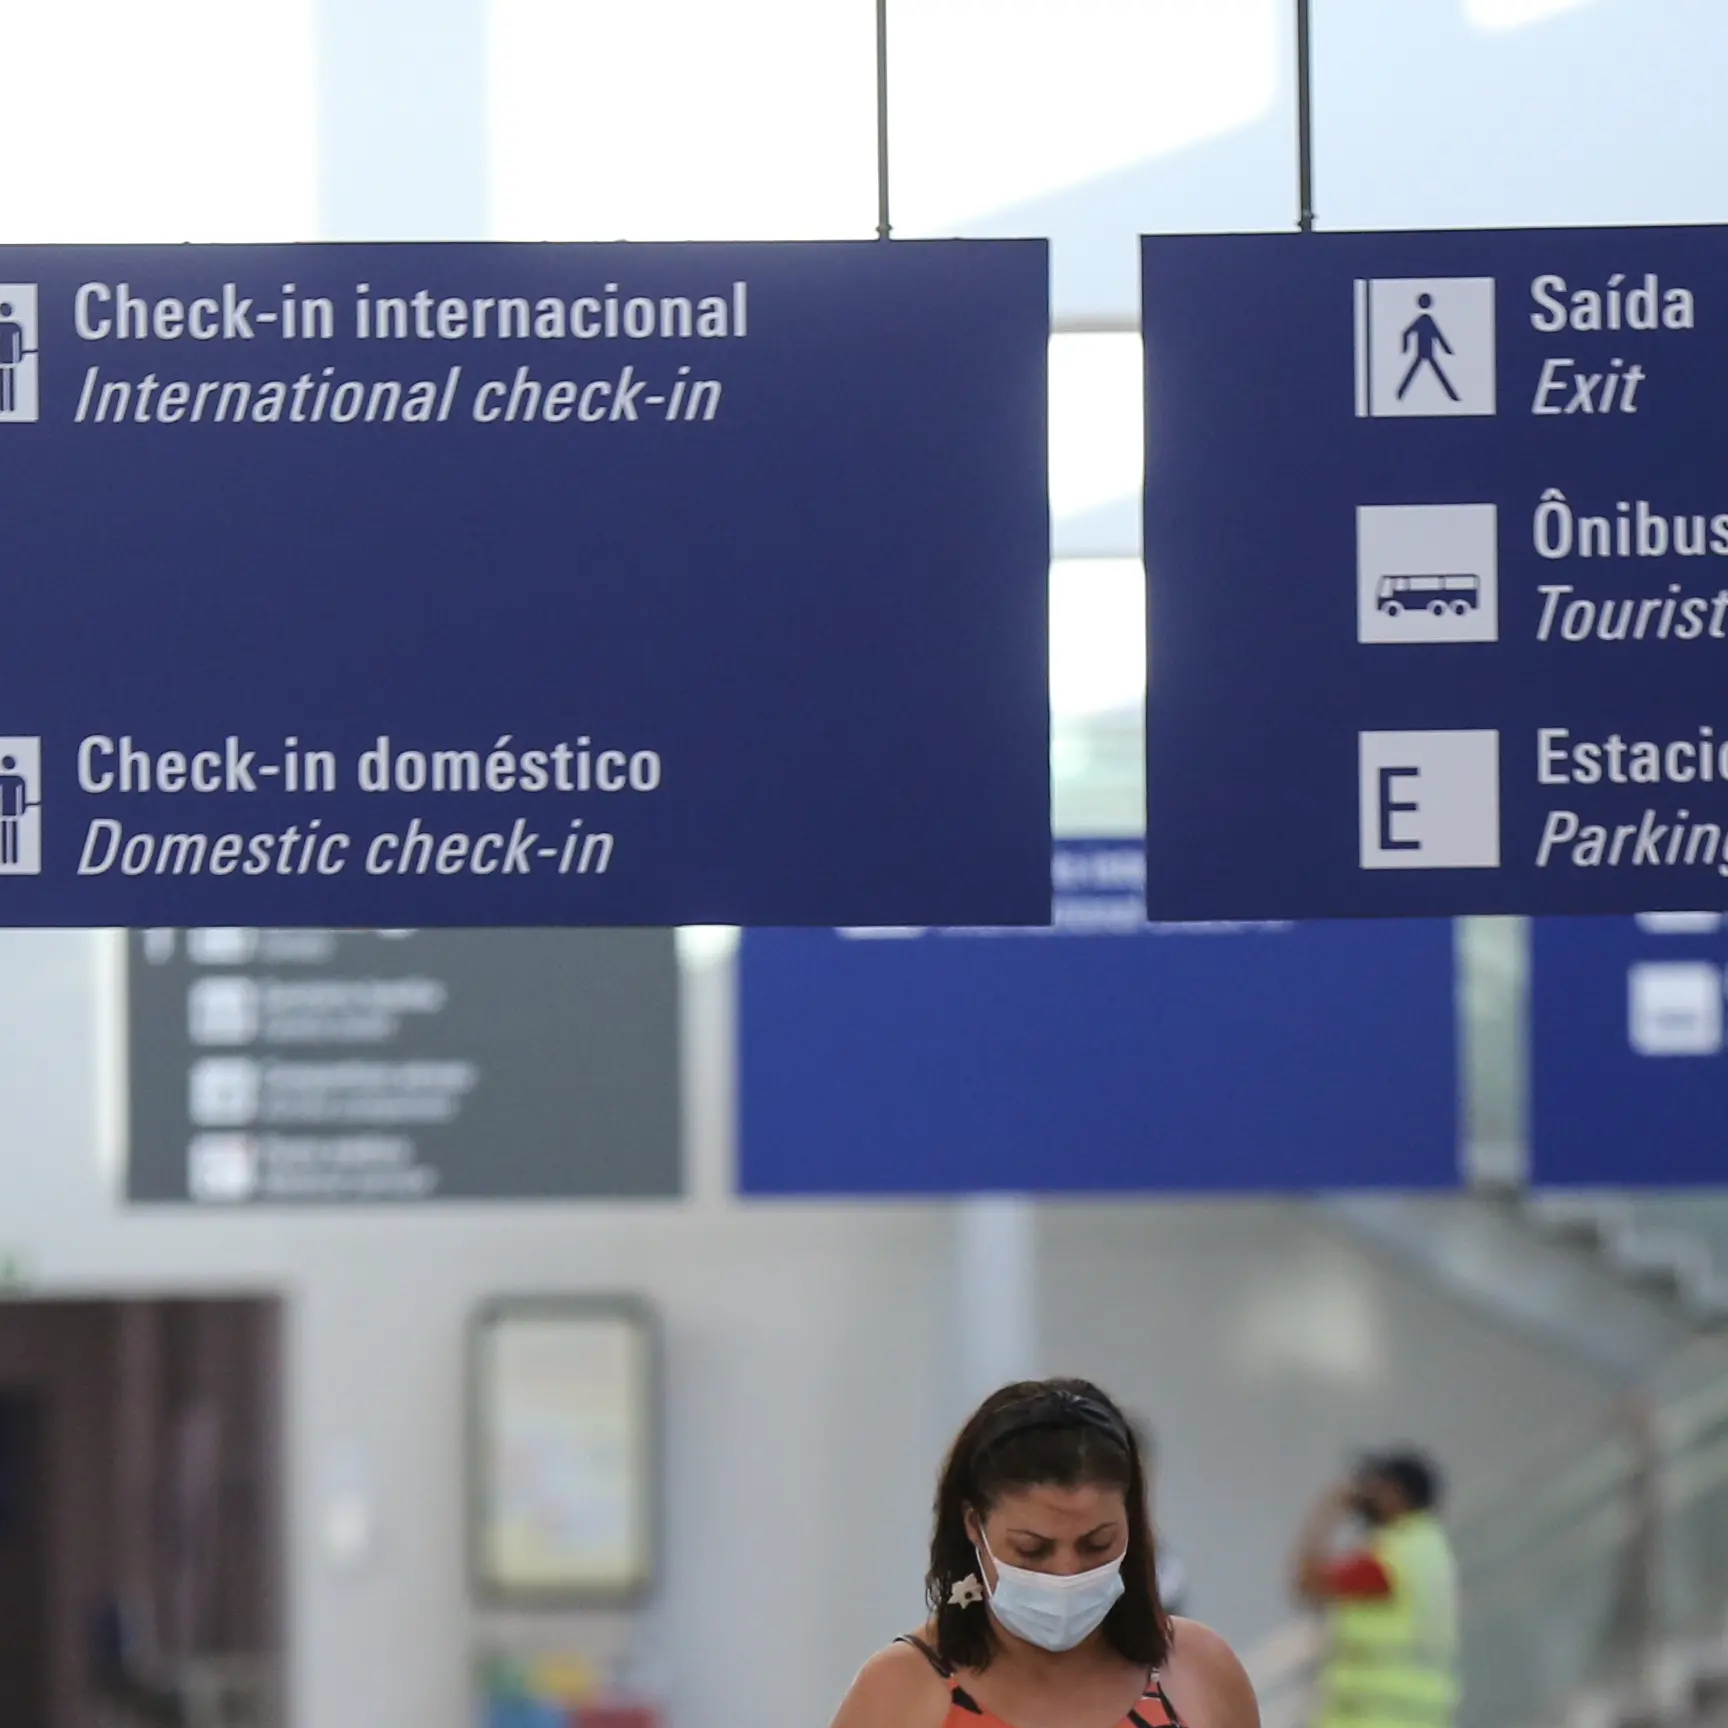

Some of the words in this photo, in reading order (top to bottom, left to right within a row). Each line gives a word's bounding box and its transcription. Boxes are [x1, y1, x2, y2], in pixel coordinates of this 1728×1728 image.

[75, 282, 333, 339] Check-in
[357, 282, 746, 338] internacional
[1531, 274, 1693, 331] Saída
[75, 366, 461, 422] International
[474, 366, 721, 422] check-in
[1532, 358, 1645, 414] Exit
[78, 735, 335, 792] Check-in
[359, 735, 660, 791] doméstico
[1379, 767, 1420, 850] E
[78, 819, 349, 875] Domestic
[366, 818, 613, 874] check-in
